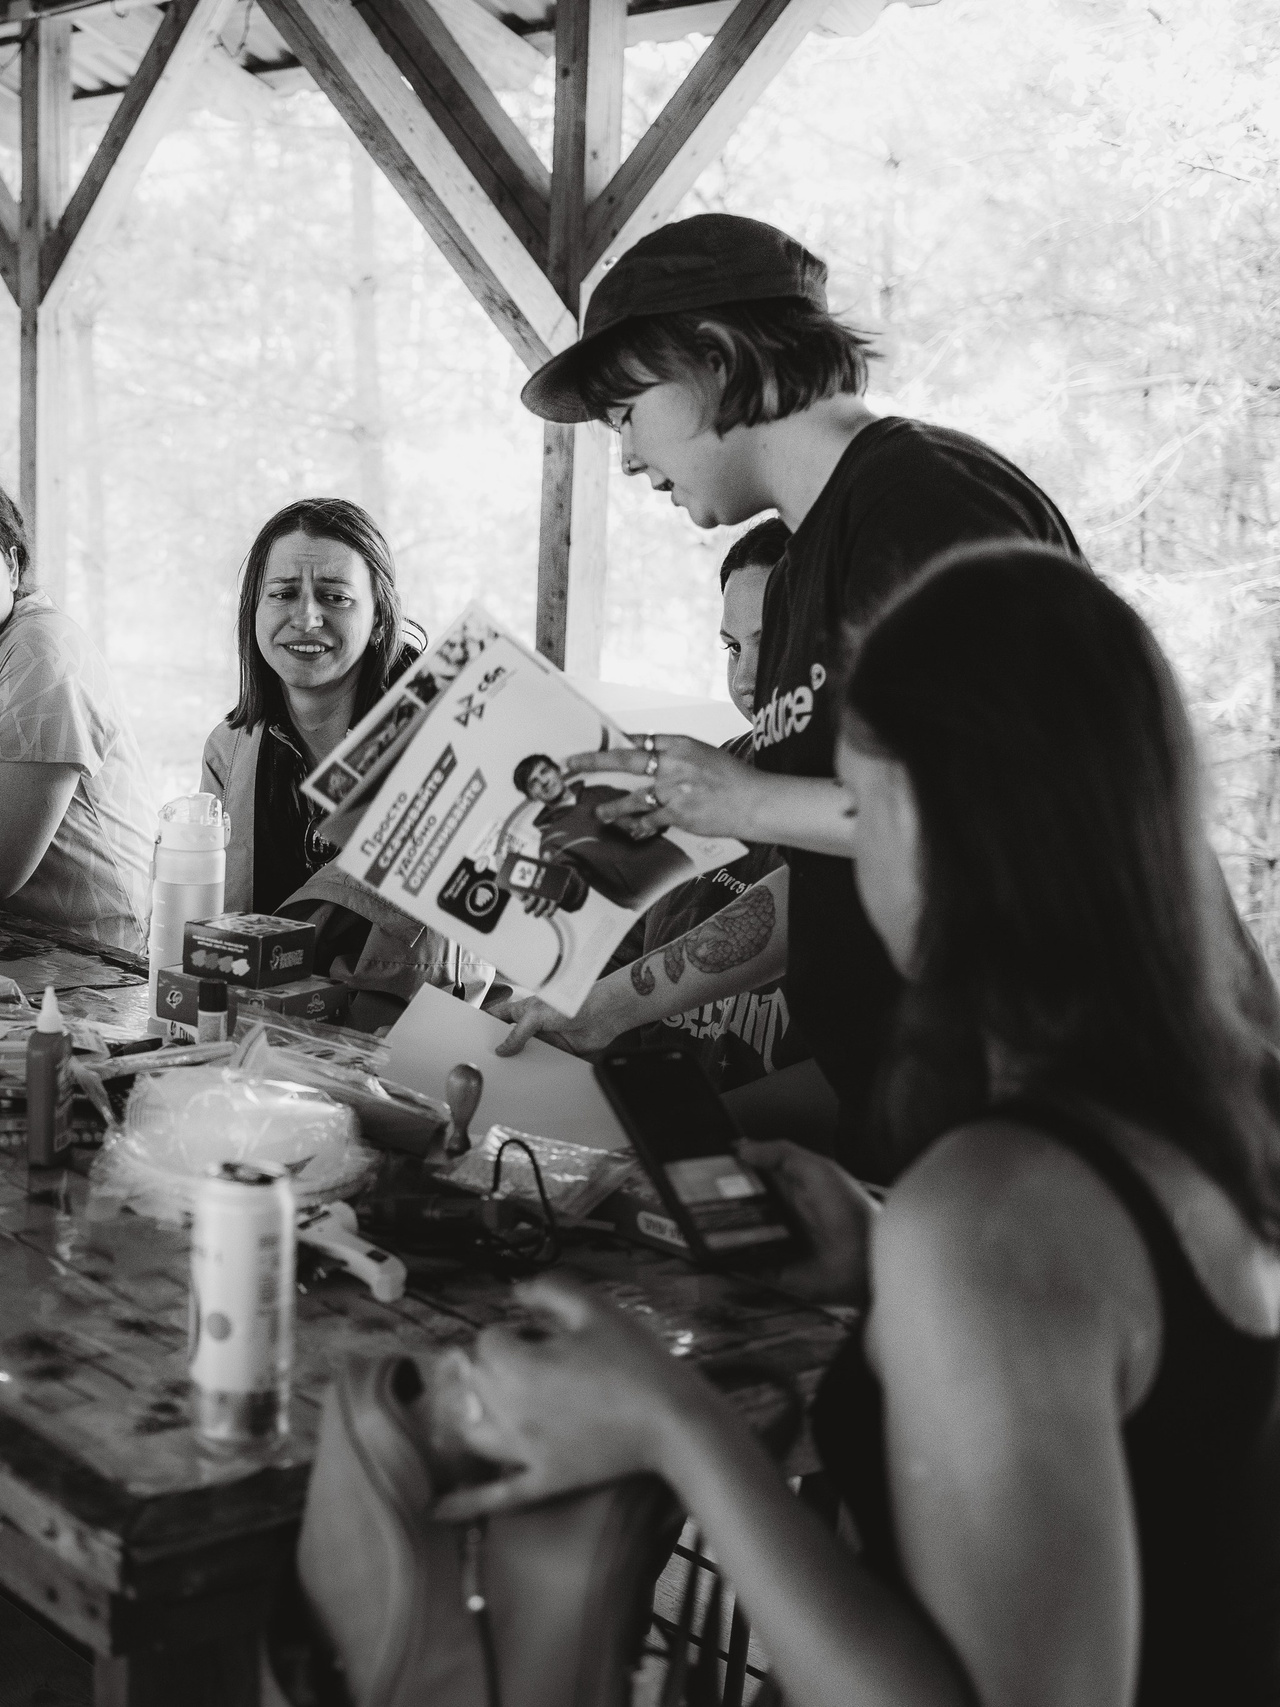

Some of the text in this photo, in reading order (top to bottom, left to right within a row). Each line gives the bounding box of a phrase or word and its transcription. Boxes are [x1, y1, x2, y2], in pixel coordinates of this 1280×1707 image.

[360, 792, 408, 857] Просто
[378, 769, 445, 869] скачивайте
[394, 815, 437, 880] удобно
[407, 776, 484, 889] оплачивайте
